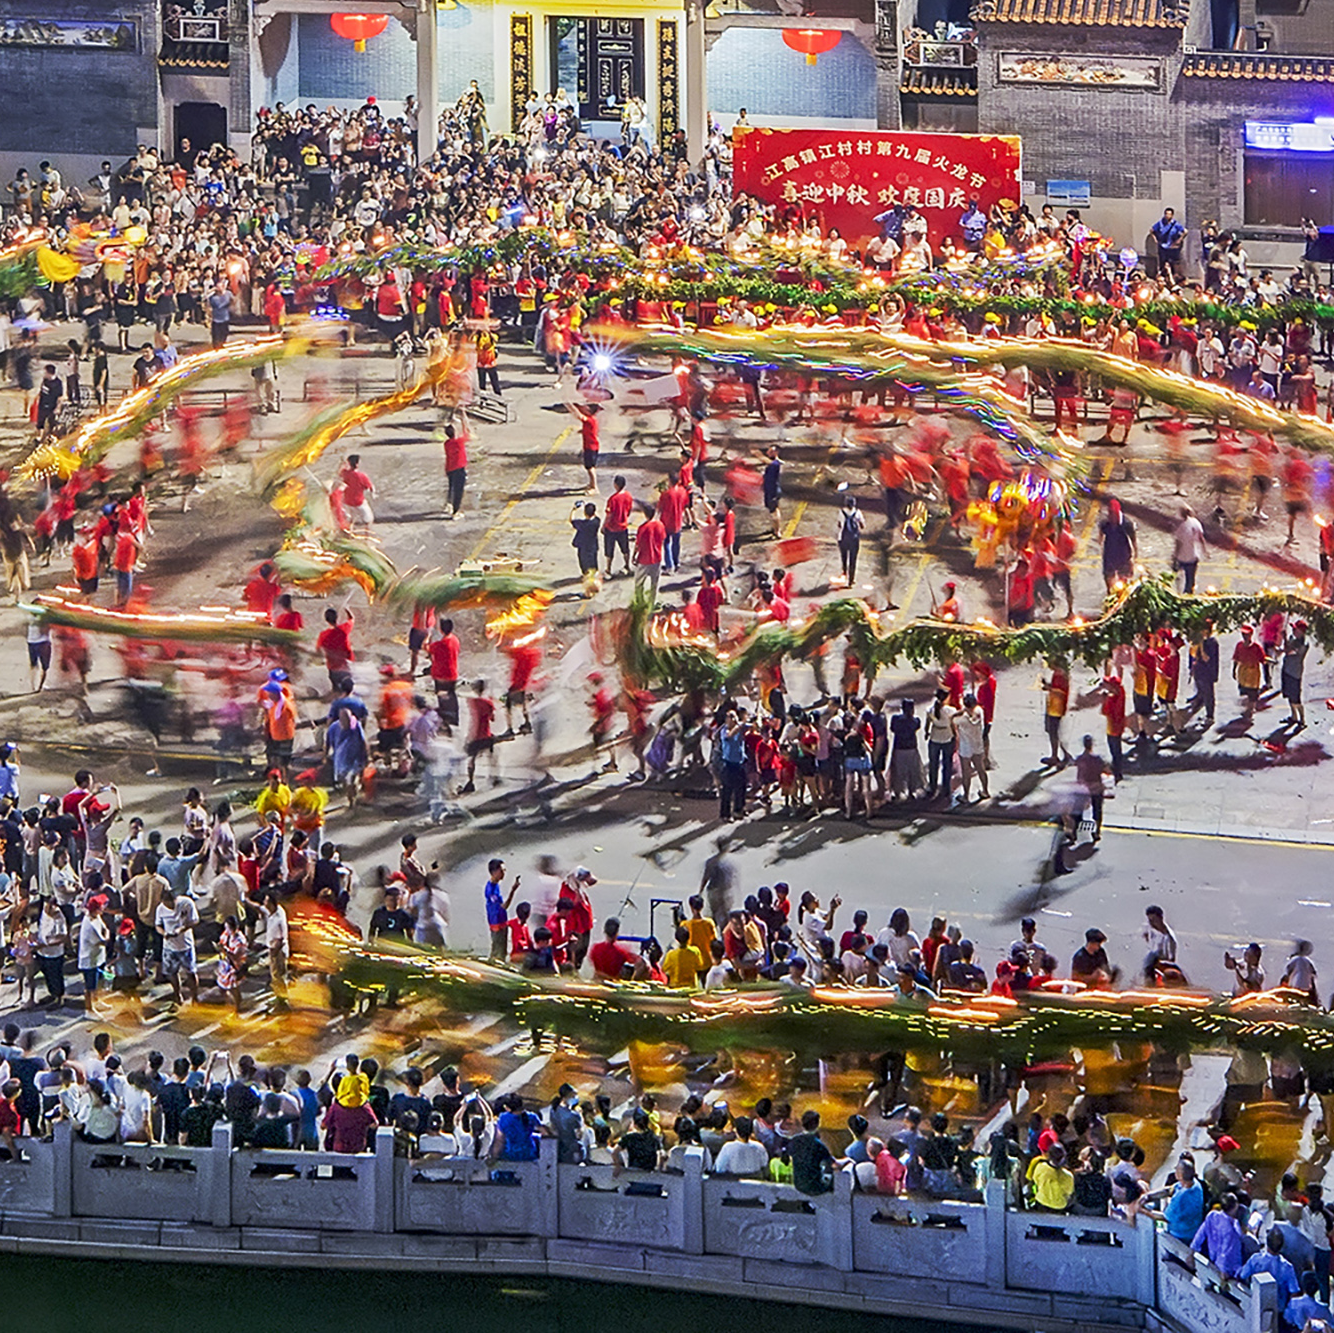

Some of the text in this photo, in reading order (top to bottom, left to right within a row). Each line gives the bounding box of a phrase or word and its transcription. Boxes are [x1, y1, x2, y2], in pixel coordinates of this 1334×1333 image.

[764, 140, 986, 189] 江高镇江村村第九届火龙节
[779, 179, 969, 210] 喜迎中秋 欢度国庆
